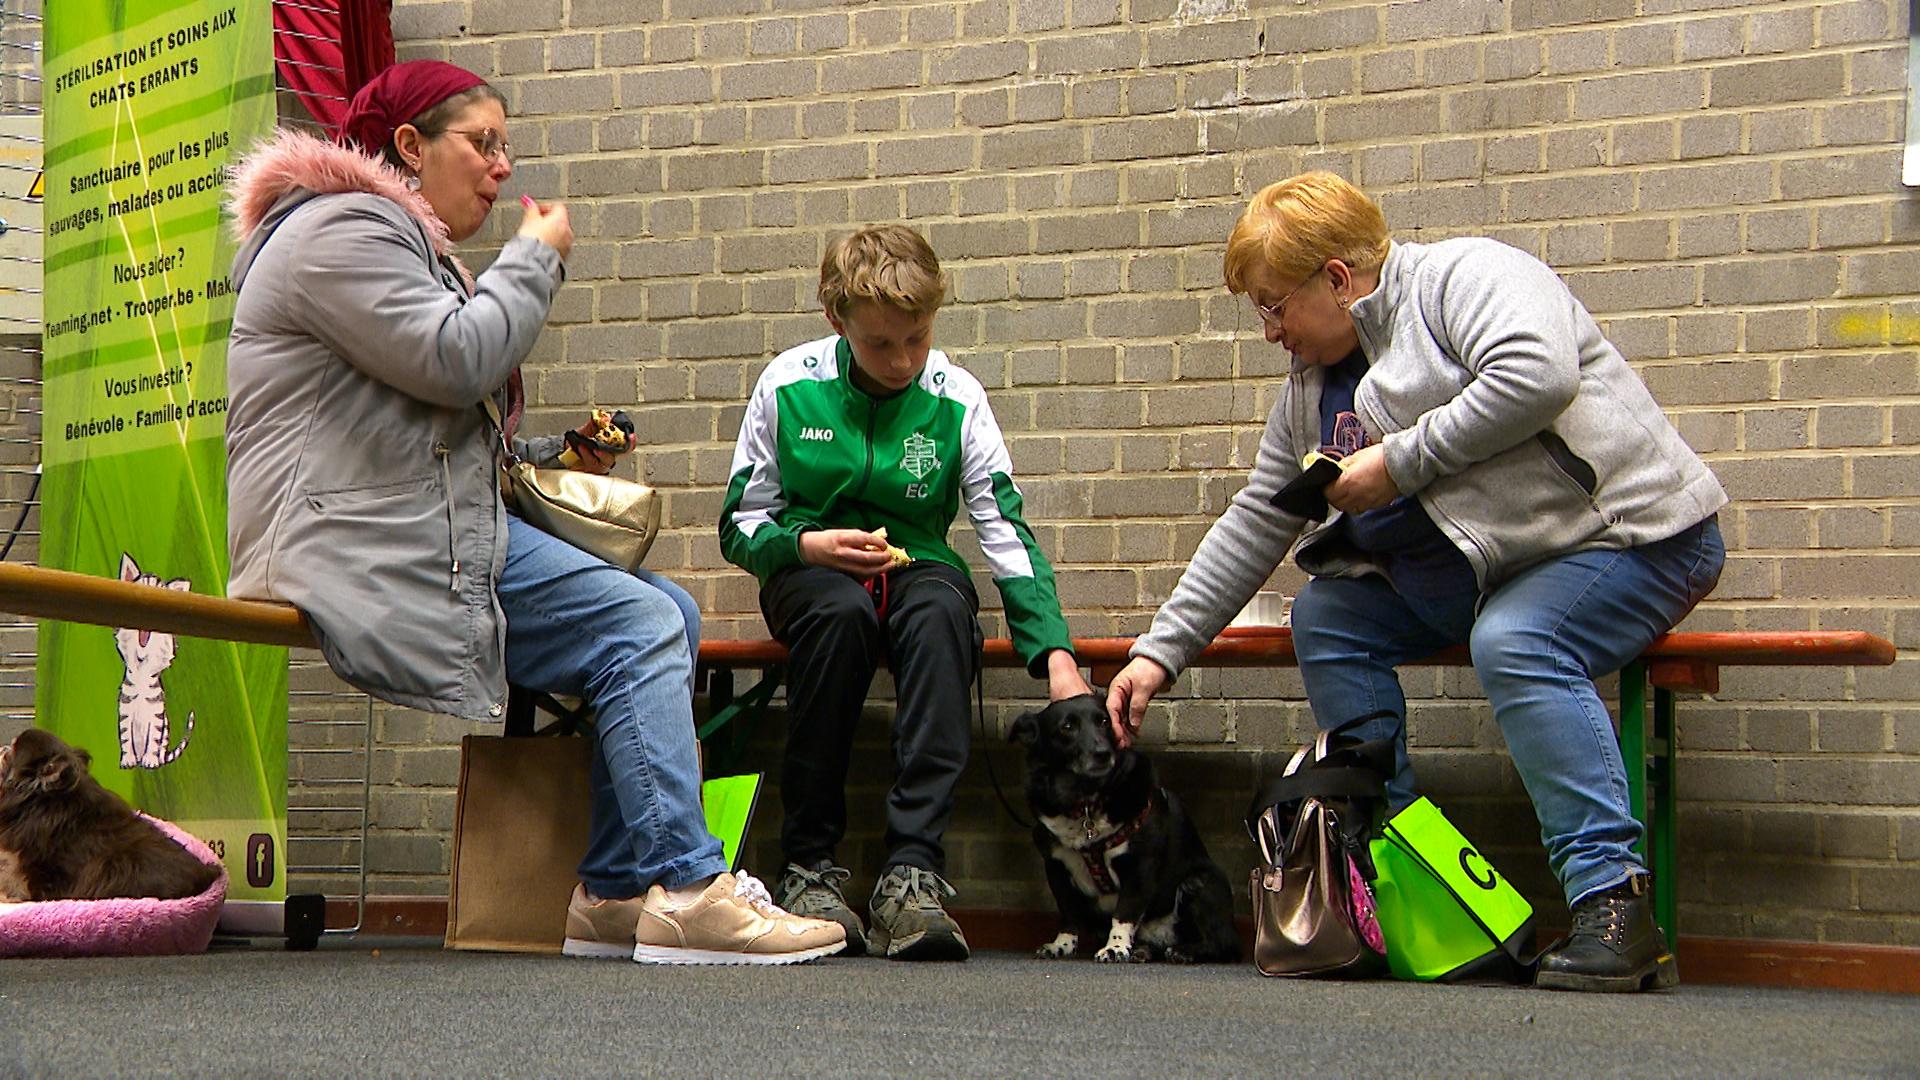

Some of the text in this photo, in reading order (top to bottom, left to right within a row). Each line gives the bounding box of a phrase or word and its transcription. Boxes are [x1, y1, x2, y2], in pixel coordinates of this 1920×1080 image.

[55, 7, 236, 94] STÉRILISATION ET SOINS AUX
[90, 57, 199, 109] CHATS ERRANTS
[70, 131, 229, 194] Sanctuaire pour les plus
[50, 165, 228, 236] sauvages, malades ou accid
[113, 247, 185, 285] Nous aider ?
[45, 308, 112, 339] Teaming.net
[124, 287, 194, 319] Trooper.be
[206, 276, 235, 299] Mak
[104, 361, 193, 398] Vous investir ?
[65, 414, 124, 441] Bénévole
[136, 402, 183, 428] Famille
[799, 427, 834, 442] JAKO
[905, 483, 929, 498] EC
